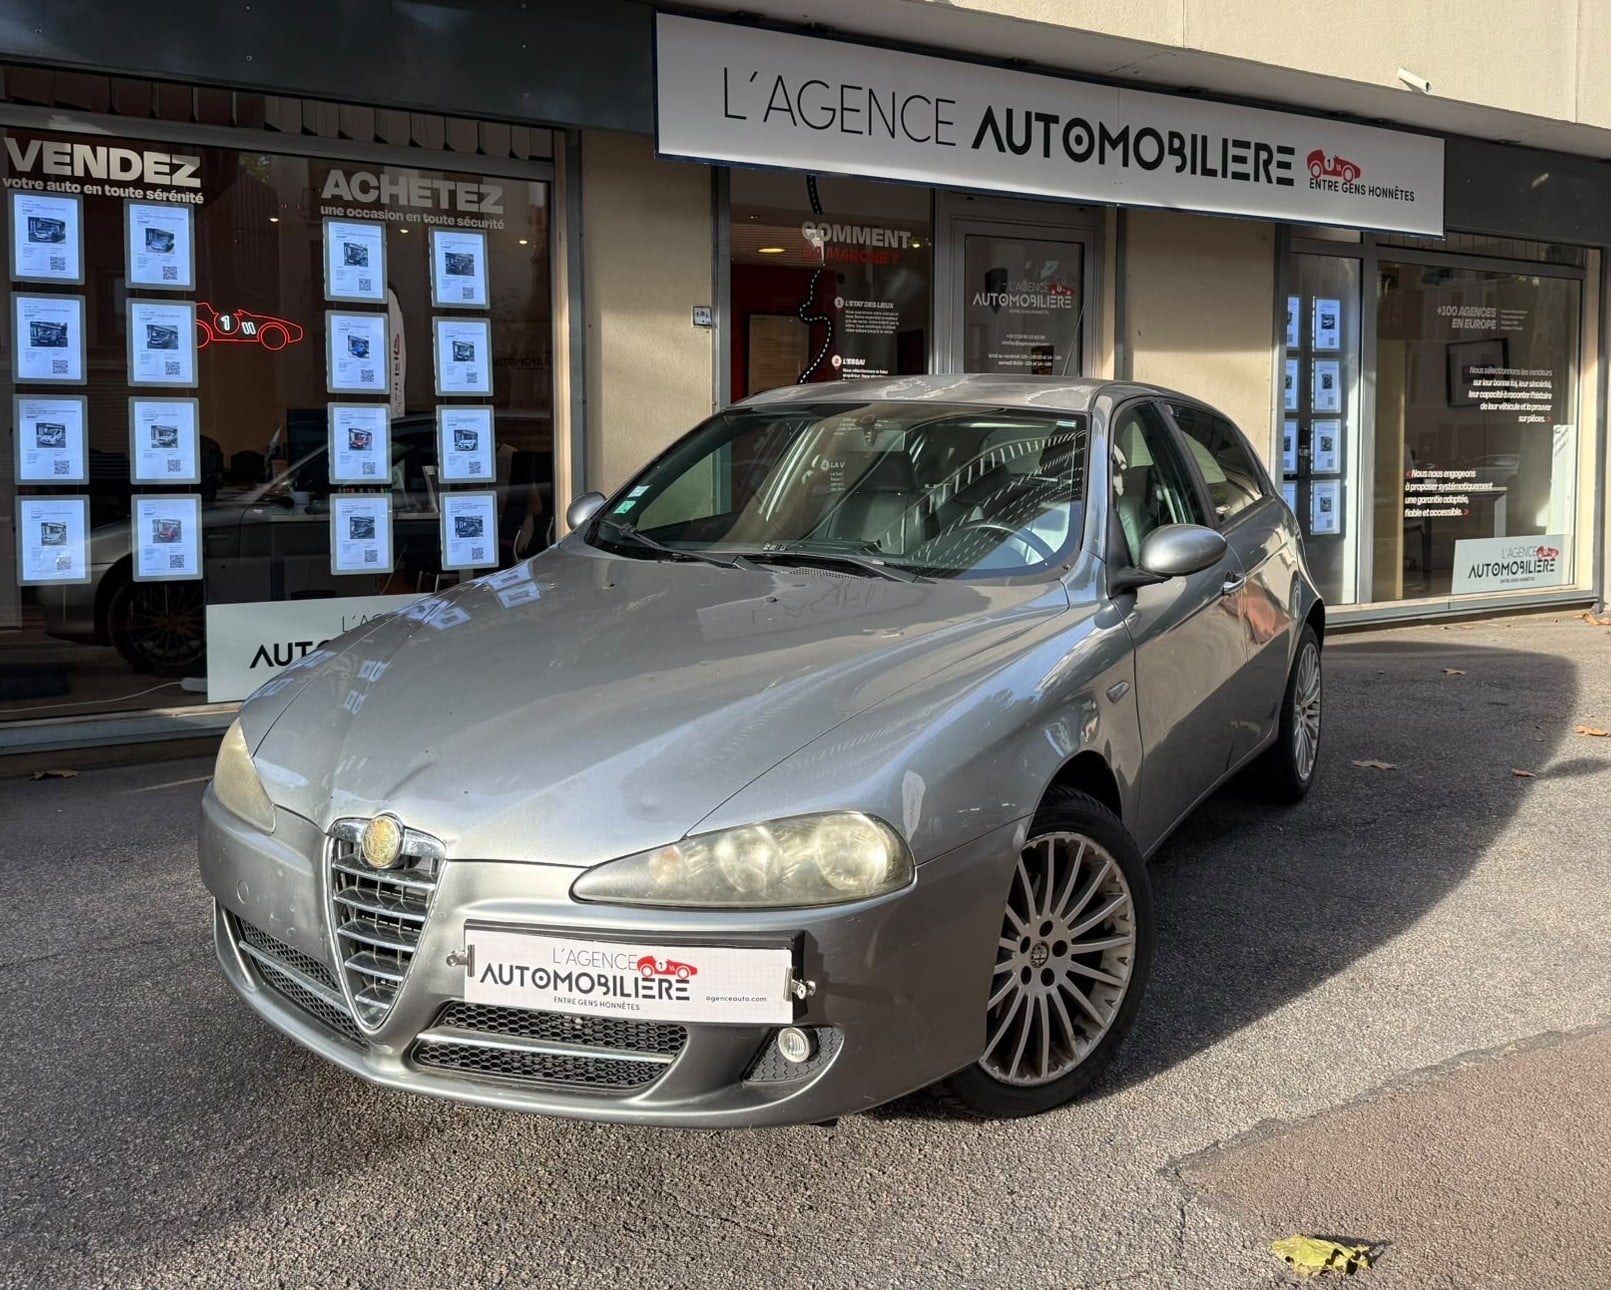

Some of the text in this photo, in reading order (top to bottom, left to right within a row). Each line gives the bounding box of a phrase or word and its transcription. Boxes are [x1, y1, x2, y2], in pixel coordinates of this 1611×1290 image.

[722, 66, 1296, 188] L'AGENCE AUTOMOBILIERE
[4, 136, 202, 188] VENDEZ
[3, 177, 205, 205] votre auto en toute sérénité
[320, 169, 504, 215] ACHETEZ
[1309, 177, 1415, 203] ENTRE GENS HONNÊTES
[320, 205, 505, 231] une occasion en toute sécurité
[801, 221, 911, 250] COMMENT
[826, 246, 889, 264] MARCHE
[972, 292, 1073, 309] AUTOMOBILIERE
[1458, 306, 1497, 319] AGENCES
[1451, 318, 1463, 329] EN
[1464, 318, 1497, 331] EUROPE
[1467, 558, 1556, 579] AUTOMOBILIERE
[552, 946, 638, 971] L'AGENCE
[479, 962, 691, 1002] AUTOMOBILIERE
[553, 996, 578, 1006] ENTRE
[577, 999, 599, 1008] GENS
